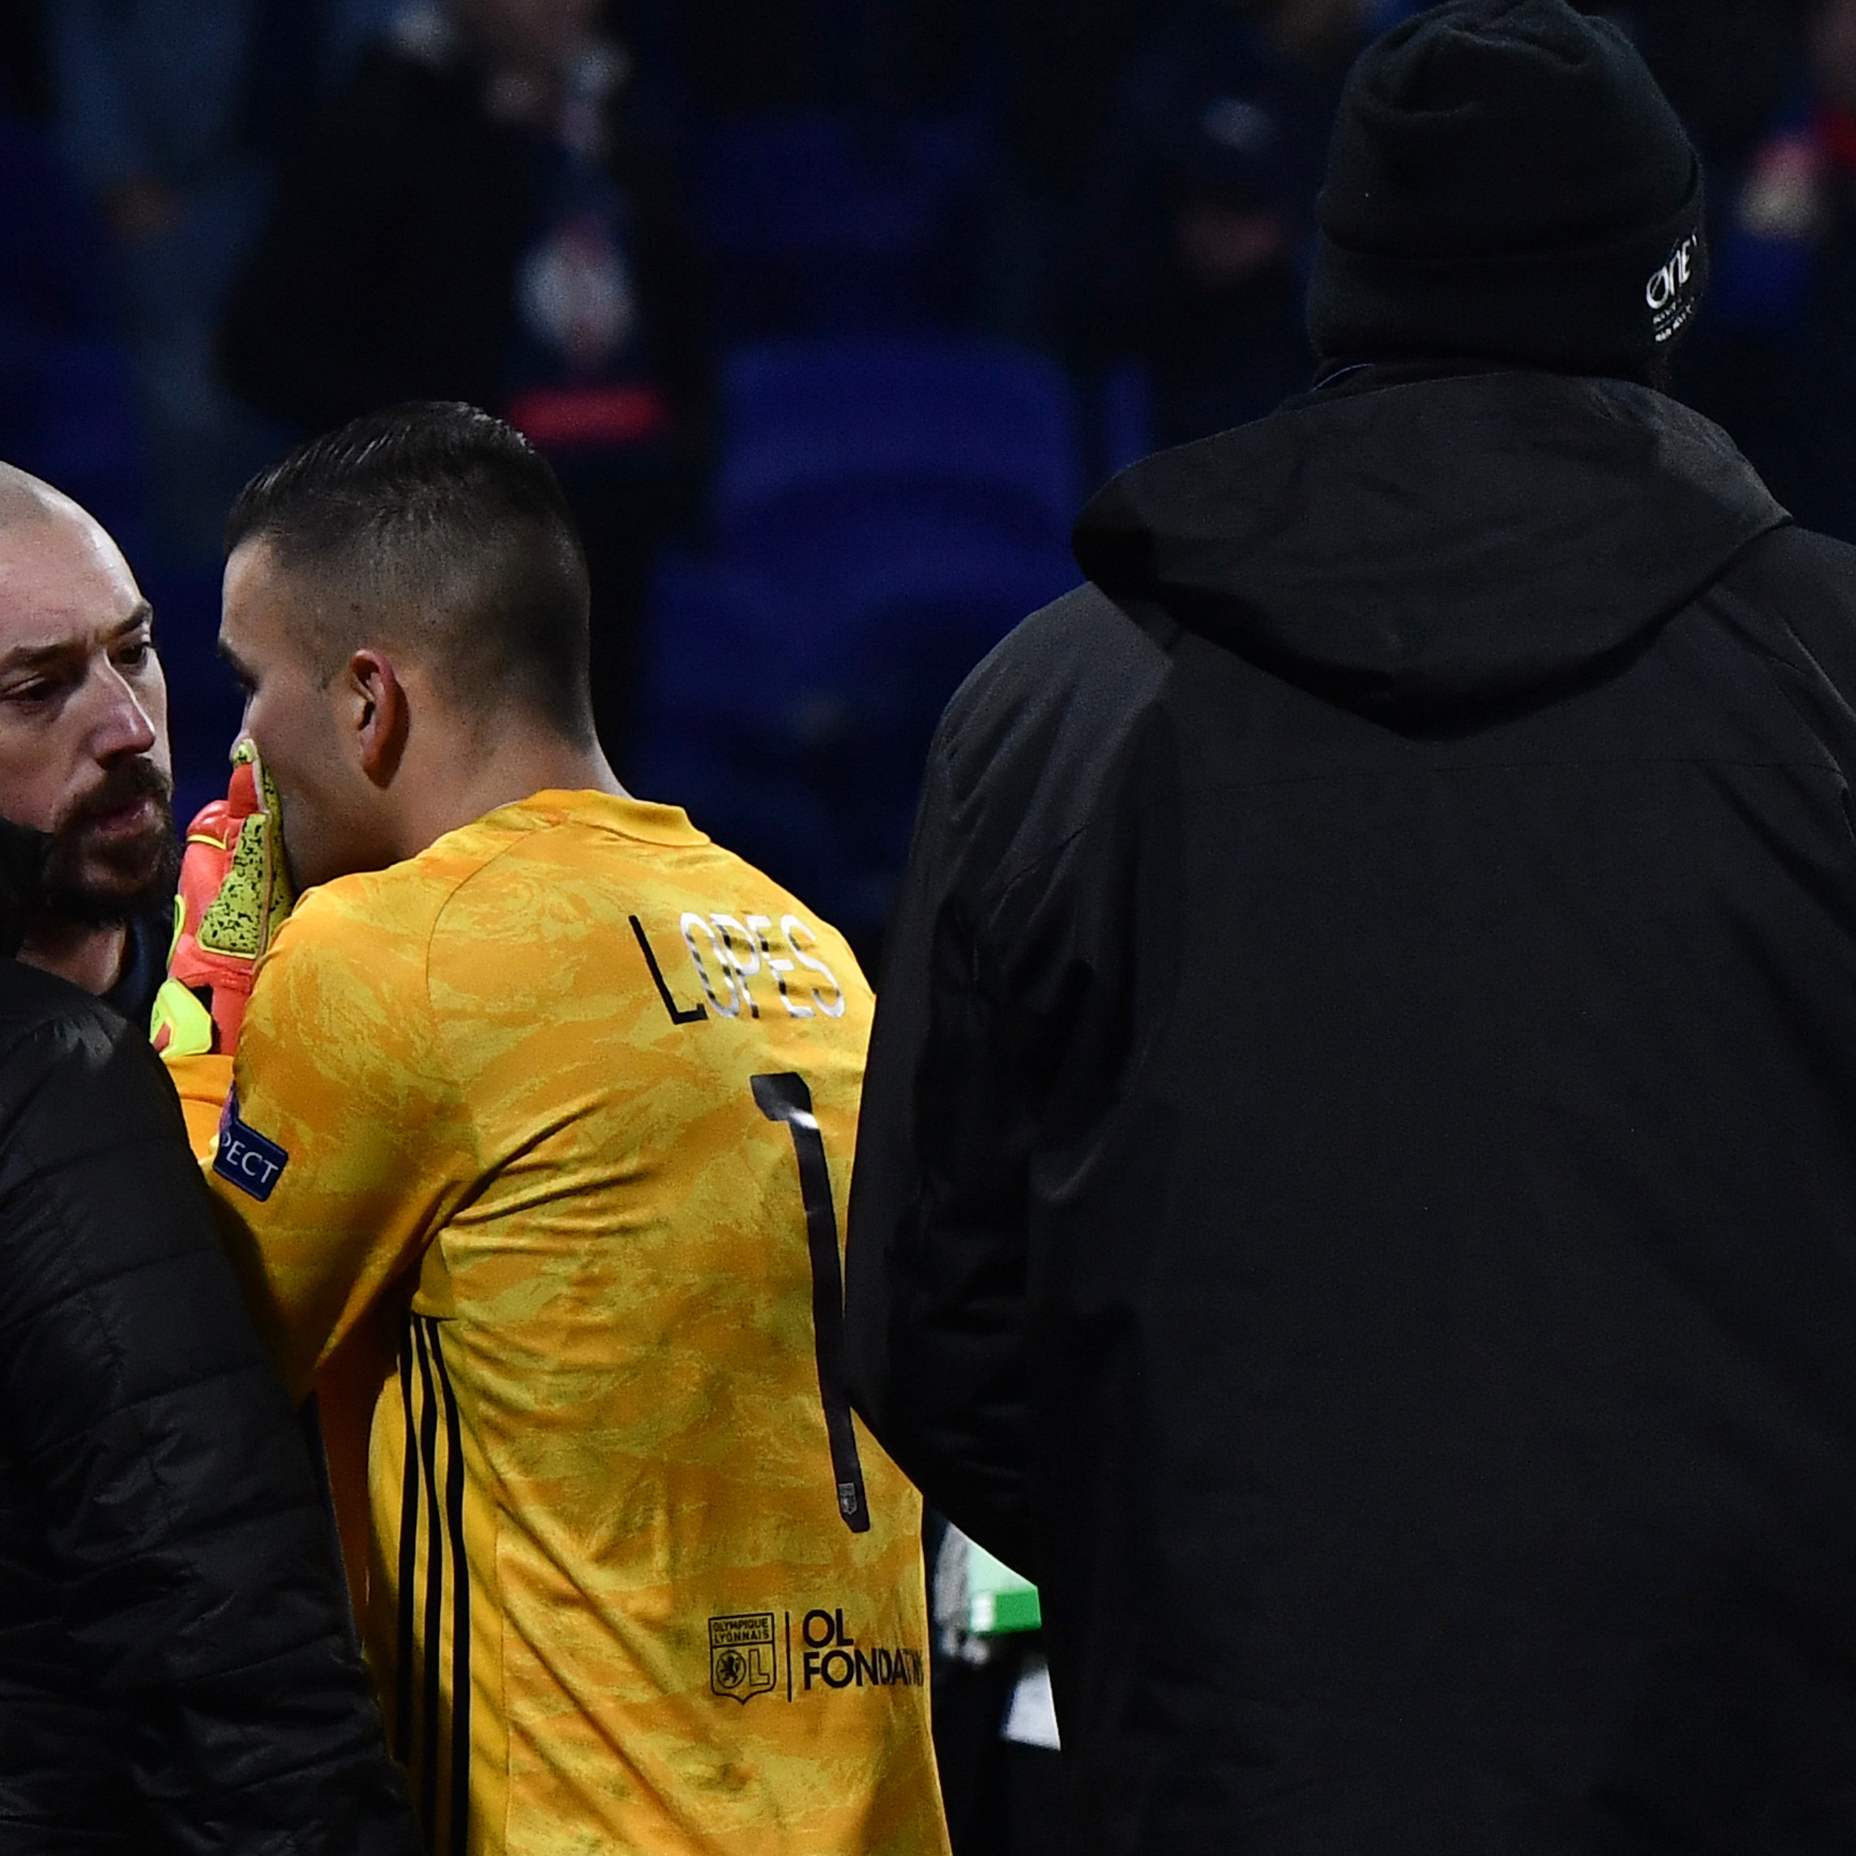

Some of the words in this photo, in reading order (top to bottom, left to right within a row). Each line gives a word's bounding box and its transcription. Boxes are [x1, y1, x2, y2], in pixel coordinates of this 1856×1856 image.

[628, 911, 846, 1025] LOPES
[749, 1071, 871, 1533] 1
[712, 1617, 769, 1635] OLYMPIQUE
[714, 1628, 770, 1644] LYONNAIS
[802, 1608, 854, 1648] OL
